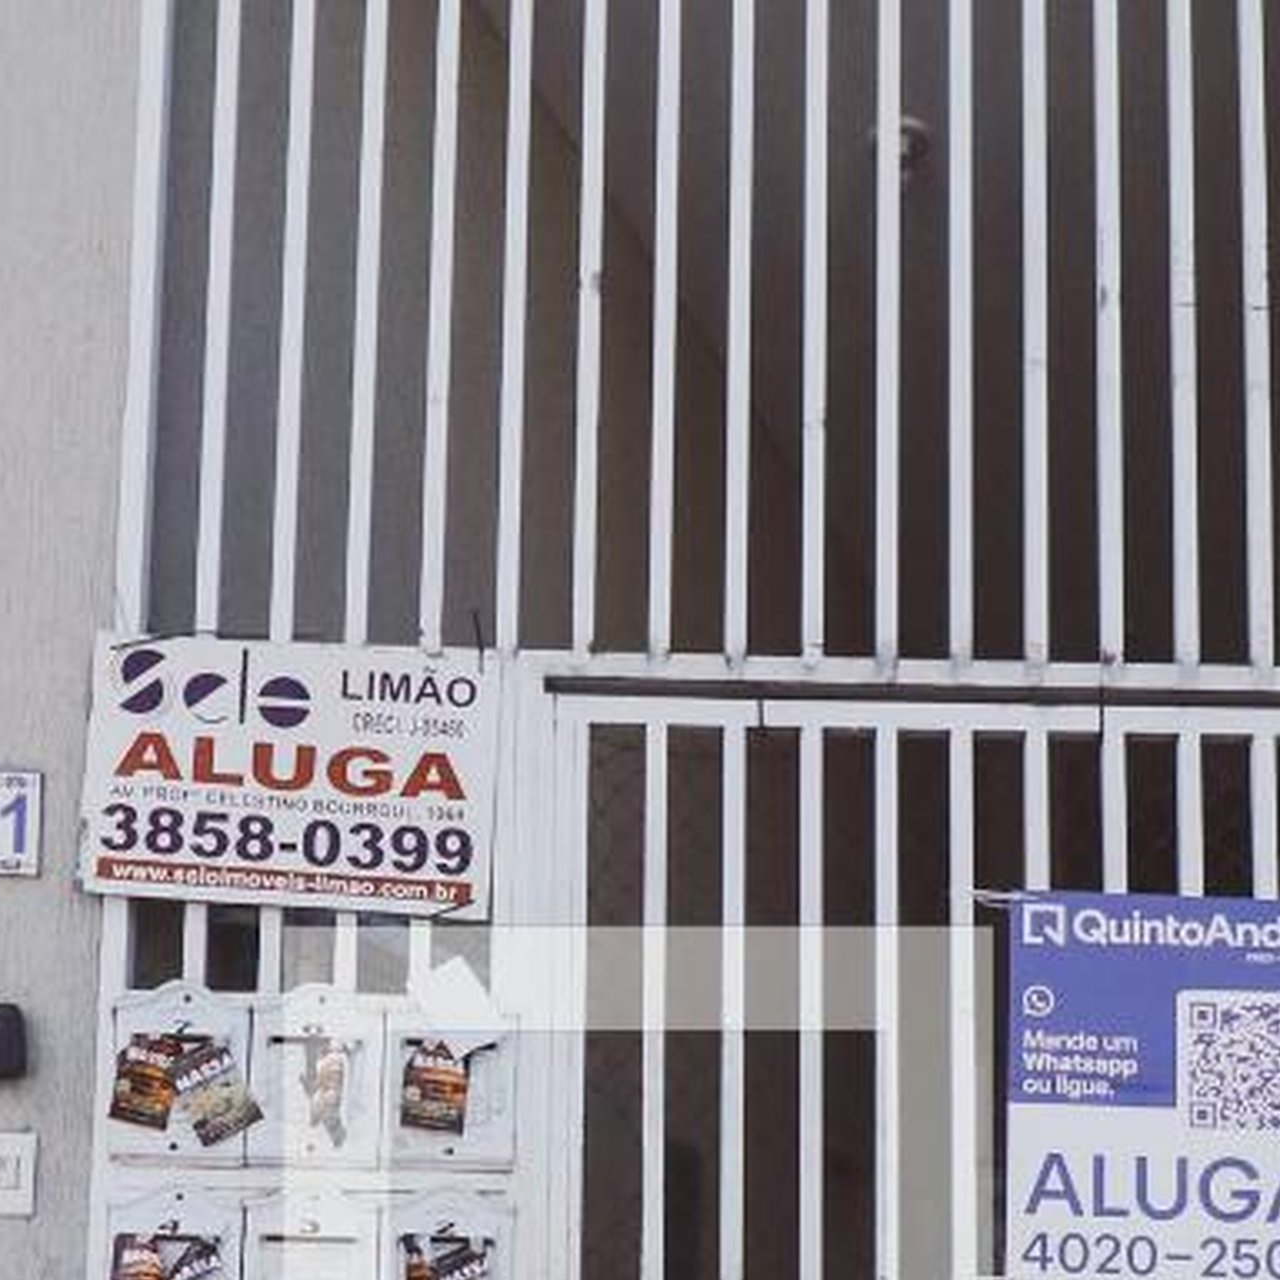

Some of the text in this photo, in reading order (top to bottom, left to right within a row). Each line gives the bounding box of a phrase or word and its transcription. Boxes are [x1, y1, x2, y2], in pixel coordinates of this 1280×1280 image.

[342, 666, 477, 708] LIMÃO
[113, 731, 468, 801] ALUGA
[100, 803, 473, 875] 3858-0399
[1022, 1029, 1139, 1053] Mande um
[1022, 1052, 1139, 1080] Whatsapp
[1022, 1073, 1116, 1100] ou ligue.
